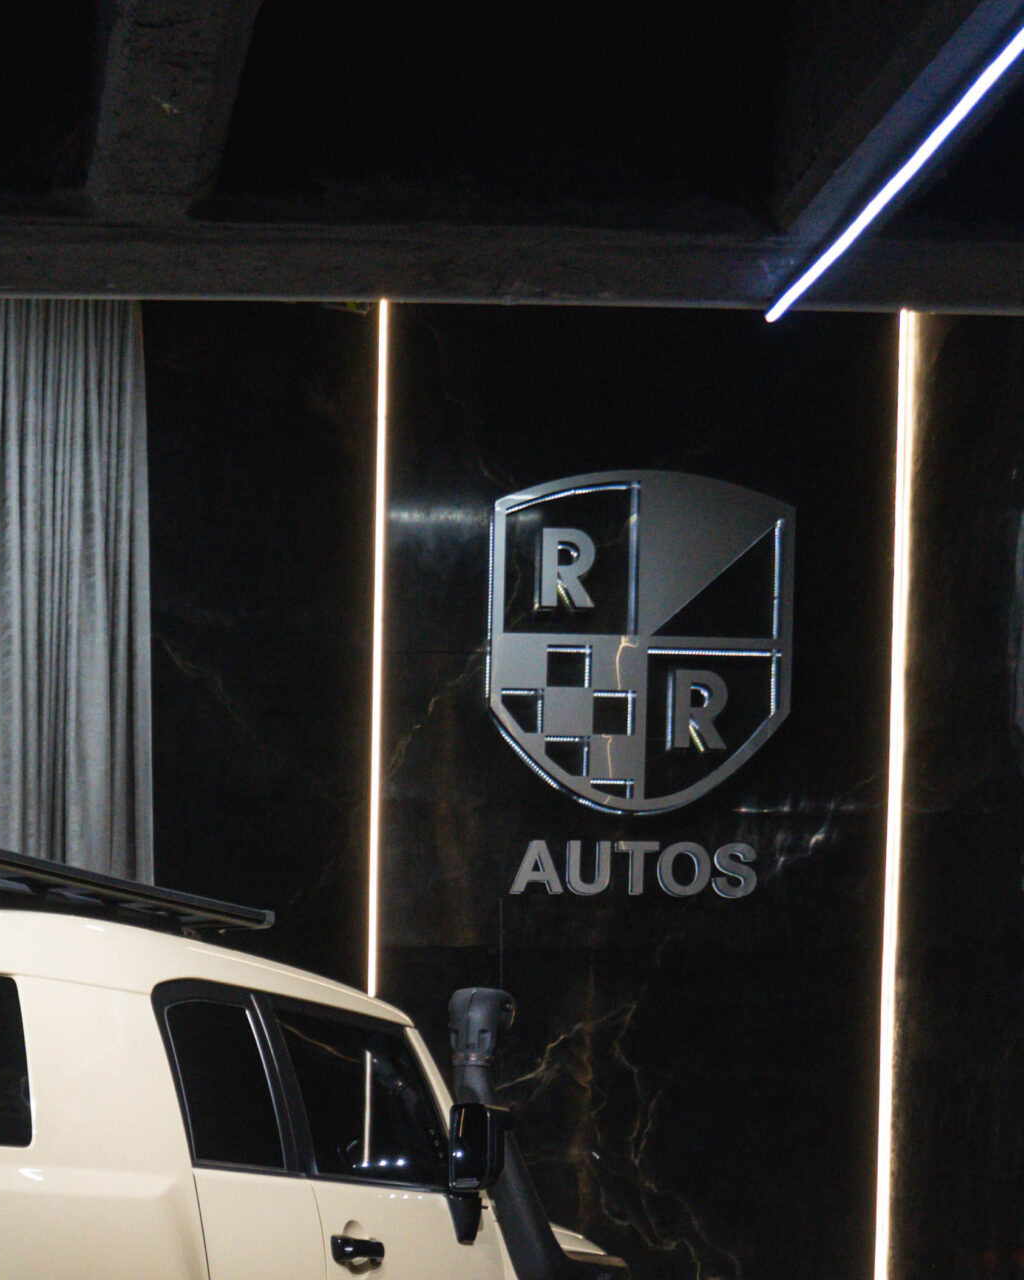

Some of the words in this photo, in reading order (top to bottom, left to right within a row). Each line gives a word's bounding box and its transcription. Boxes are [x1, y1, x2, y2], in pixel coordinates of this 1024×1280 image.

[536, 527, 596, 610] R
[666, 669, 729, 752] R
[509, 839, 758, 897] AUTOS
